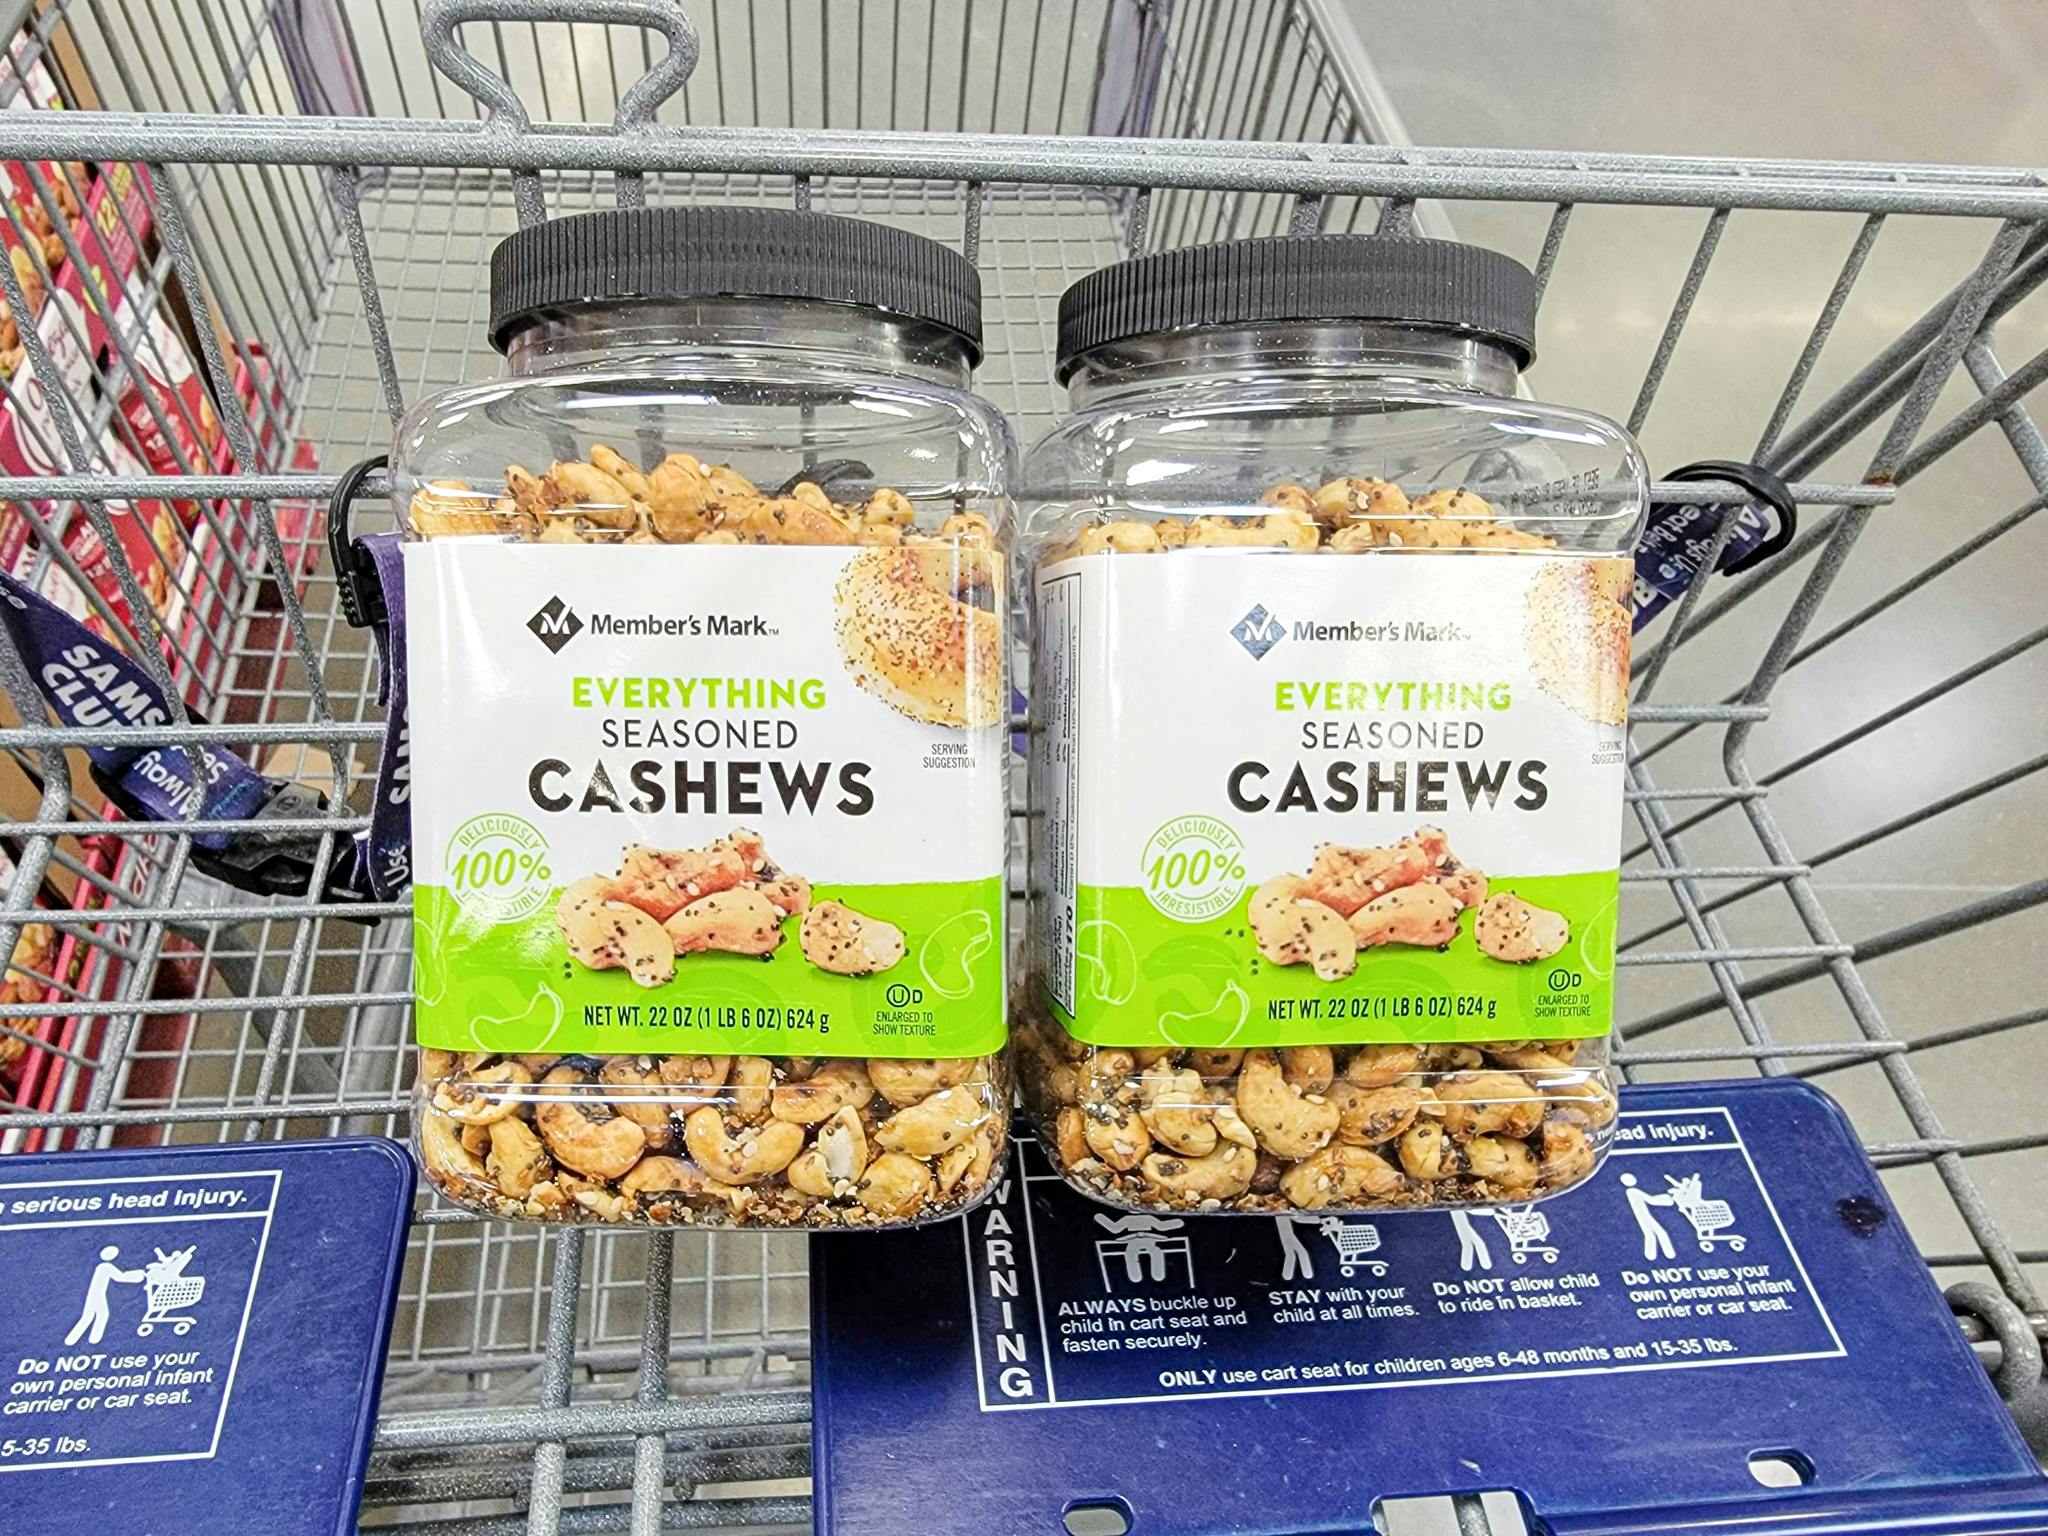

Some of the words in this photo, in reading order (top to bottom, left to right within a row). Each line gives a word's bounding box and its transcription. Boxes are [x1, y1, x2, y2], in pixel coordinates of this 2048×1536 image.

[591, 614, 701, 636] Member's
[707, 615, 768, 636] Mark
[1293, 621, 1400, 642] Member's
[1404, 622, 1461, 642] Mark
[573, 677, 826, 709] EVERYTHING
[1275, 682, 1512, 711] EVERYTHING
[602, 719, 798, 748] SEASONED
[1302, 721, 1484, 749] SEASONED
[931, 743, 968, 755] SERVING
[922, 756, 976, 768] SUGGESTION
[528, 758, 875, 816] CASHEWS
[1227, 759, 1549, 813] CASHEWS
[459, 818, 541, 849] DELICIOUSLY
[1156, 819, 1236, 849] DELICIOUSLY
[451, 848, 551, 891] 100%
[1146, 848, 1246, 891] 100%
[1155, 885, 1236, 916] IRRESISTIBLE
[1268, 1000, 1295, 1020] NET
[1299, 999, 1324, 1019] WT.
[1328, 999, 1346, 1018] 22
[1351, 998, 1369, 1018] OZ
[1373, 998, 1387, 1019] (1
[1392, 997, 1409, 1017] LB
[1415, 998, 1423, 1017] 6
[1428, 997, 1453, 1018] OZ)
[1457, 996, 1483, 1016] 624
[1487, 1000, 1497, 1019] g
[1534, 1006, 1557, 1018] SHOW
[1559, 1006, 1591, 1017] TEXTURE
[1538, 994, 1578, 1006] ENLARGED
[1580, 994, 1590, 1005] TO
[584, 1005, 612, 1027] NET
[617, 1006, 644, 1027] WT.
[649, 1006, 667, 1027] 22
[673, 1007, 693, 1027] OZ
[697, 1006, 711, 1030] (1
[717, 1007, 736, 1028] LB
[742, 1008, 750, 1028] 6
[756, 1007, 781, 1031] OZ)
[787, 1009, 815, 1029] 624
[819, 1012, 830, 1034] g
[876, 1011, 920, 1023] ENLARGED
[922, 1012, 933, 1023] TO
[873, 1024, 898, 1035] SHOW
[900, 1024, 936, 1036] TEXTURE
[1648, 1122, 1714, 1142] injury.
[11, 1195, 103, 1215] serious
[108, 1190, 169, 1210] head
[173, 1188, 248, 1208] injury.
[1433, 1281, 1460, 1297] Do
[1465, 1279, 1506, 1295] NOT
[1510, 1276, 1555, 1292] allow
[1558, 1273, 1601, 1289] child
[1621, 1270, 1650, 1286] Do
[1652, 1268, 1692, 1284] NOT
[1697, 1267, 1729, 1282] use
[1732, 1265, 1770, 1282] your
[1269, 1289, 1320, 1305] STAY
[1326, 1287, 1362, 1302] with
[1366, 1286, 1405, 1303] your
[1438, 1299, 1456, 1314] to
[1460, 1296, 1494, 1312] ride
[1498, 1296, 1515, 1310] in
[1519, 1292, 1583, 1309] basket.
[1629, 1289, 1667, 1303] own
[1671, 1282, 1744, 1304] personal
[1746, 1278, 1796, 1295] infant
[1059, 1298, 1146, 1316] ALWAYS
[1150, 1295, 1209, 1312] buckle
[1213, 1295, 1236, 1311] up
[1273, 1307, 1315, 1323] child
[1320, 1307, 1338, 1321] at
[1342, 1304, 1363, 1319] all
[1366, 1302, 1420, 1318] times.
[1636, 1303, 1692, 1320] carrier
[1696, 1302, 1714, 1316] or
[1717, 1301, 1745, 1315] car
[1749, 1296, 1793, 1313] seat.
[1060, 1316, 1103, 1334] child
[1108, 1315, 1125, 1331] in
[1130, 1315, 1164, 1330] cart
[1170, 1313, 1208, 1328] seat
[1213, 1311, 1247, 1326] and
[1062, 1336, 1120, 1353] fasten
[1125, 1332, 1207, 1350] securely.
[17, 1358, 50, 1375] Do
[55, 1354, 107, 1372] NOT
[110, 1354, 148, 1369] use
[152, 1351, 200, 1370] your
[1159, 1369, 1217, 1388] ONLY
[1222, 1370, 1257, 1385] use
[1261, 1366, 1296, 1382] cart
[1301, 1364, 1341, 1380] seat
[1344, 1360, 1370, 1377] for
[1373, 1355, 1446, 1374] children
[1450, 1355, 1494, 1375] ages
[1499, 1350, 1541, 1368] 6-48
[1544, 1346, 1610, 1364] months
[1613, 1341, 1649, 1359] and
[1651, 1338, 1702, 1356] 15-35
[1705, 1337, 1738, 1353] lbs.
[10, 1379, 54, 1395] own
[58, 1371, 151, 1395] personal
[155, 1367, 214, 1386] infant
[3, 1395, 74, 1415] carrier
[76, 1396, 100, 1410] or
[103, 1394, 140, 1409] car
[143, 1388, 193, 1407] seat.
[0, 1437, 51, 1457] 5-35
[55, 1436, 91, 1455] lbs.
